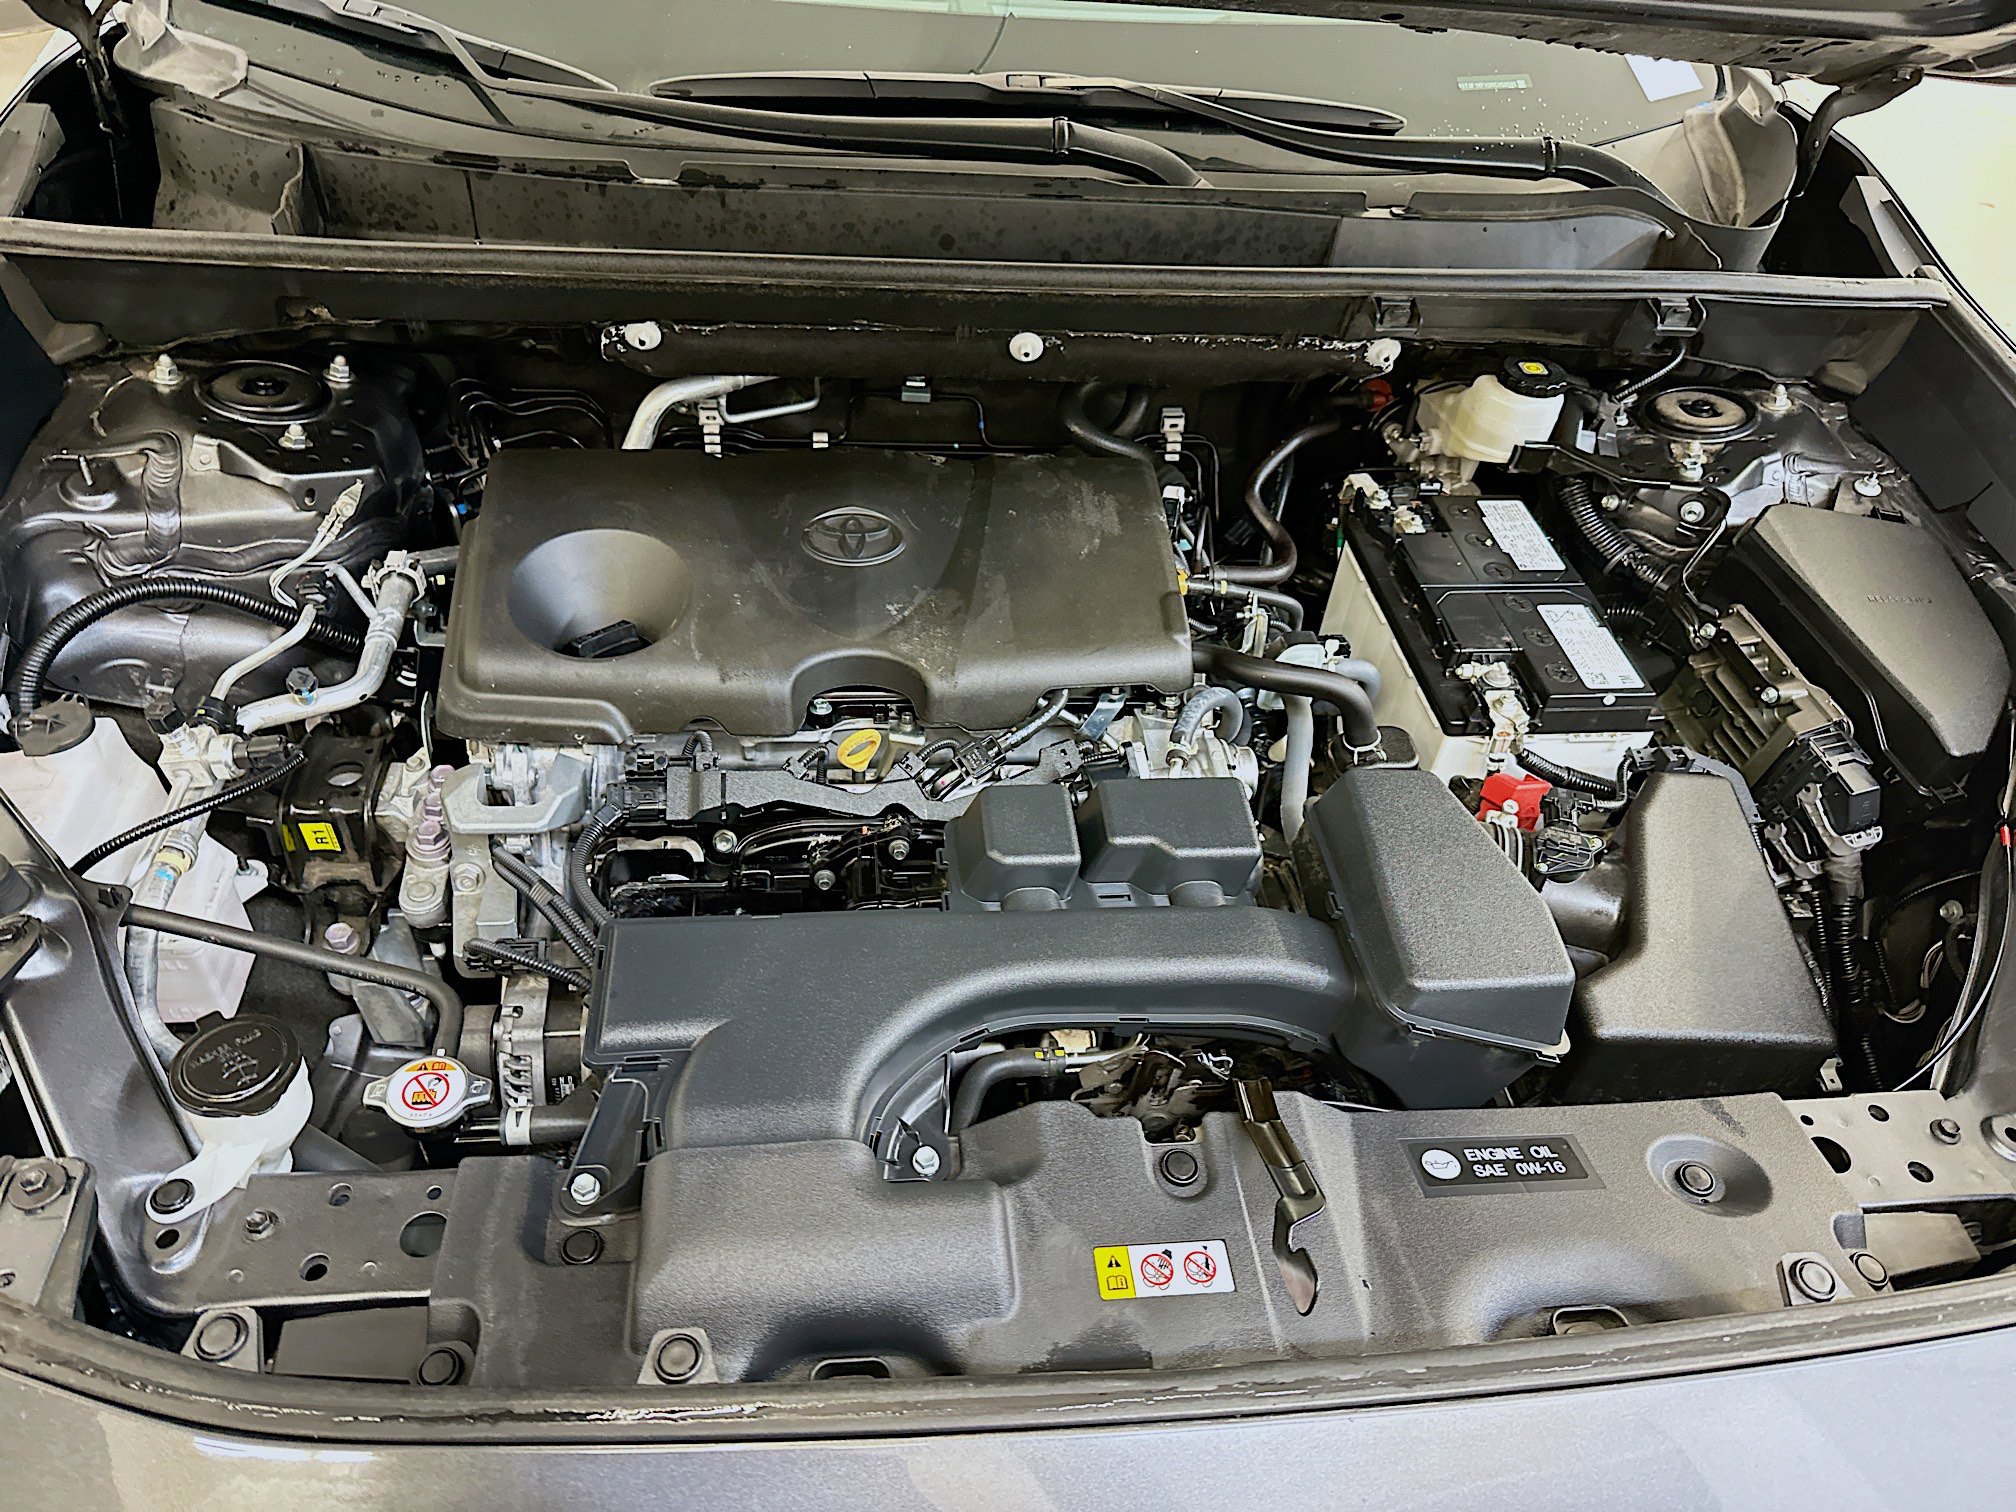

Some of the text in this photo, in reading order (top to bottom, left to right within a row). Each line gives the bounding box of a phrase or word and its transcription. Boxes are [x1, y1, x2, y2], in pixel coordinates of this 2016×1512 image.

[311, 830, 330, 844] R1
[1463, 1145, 1558, 1162] ENGINE OIL
[1472, 1160, 1567, 1178] SAE 0W-16
